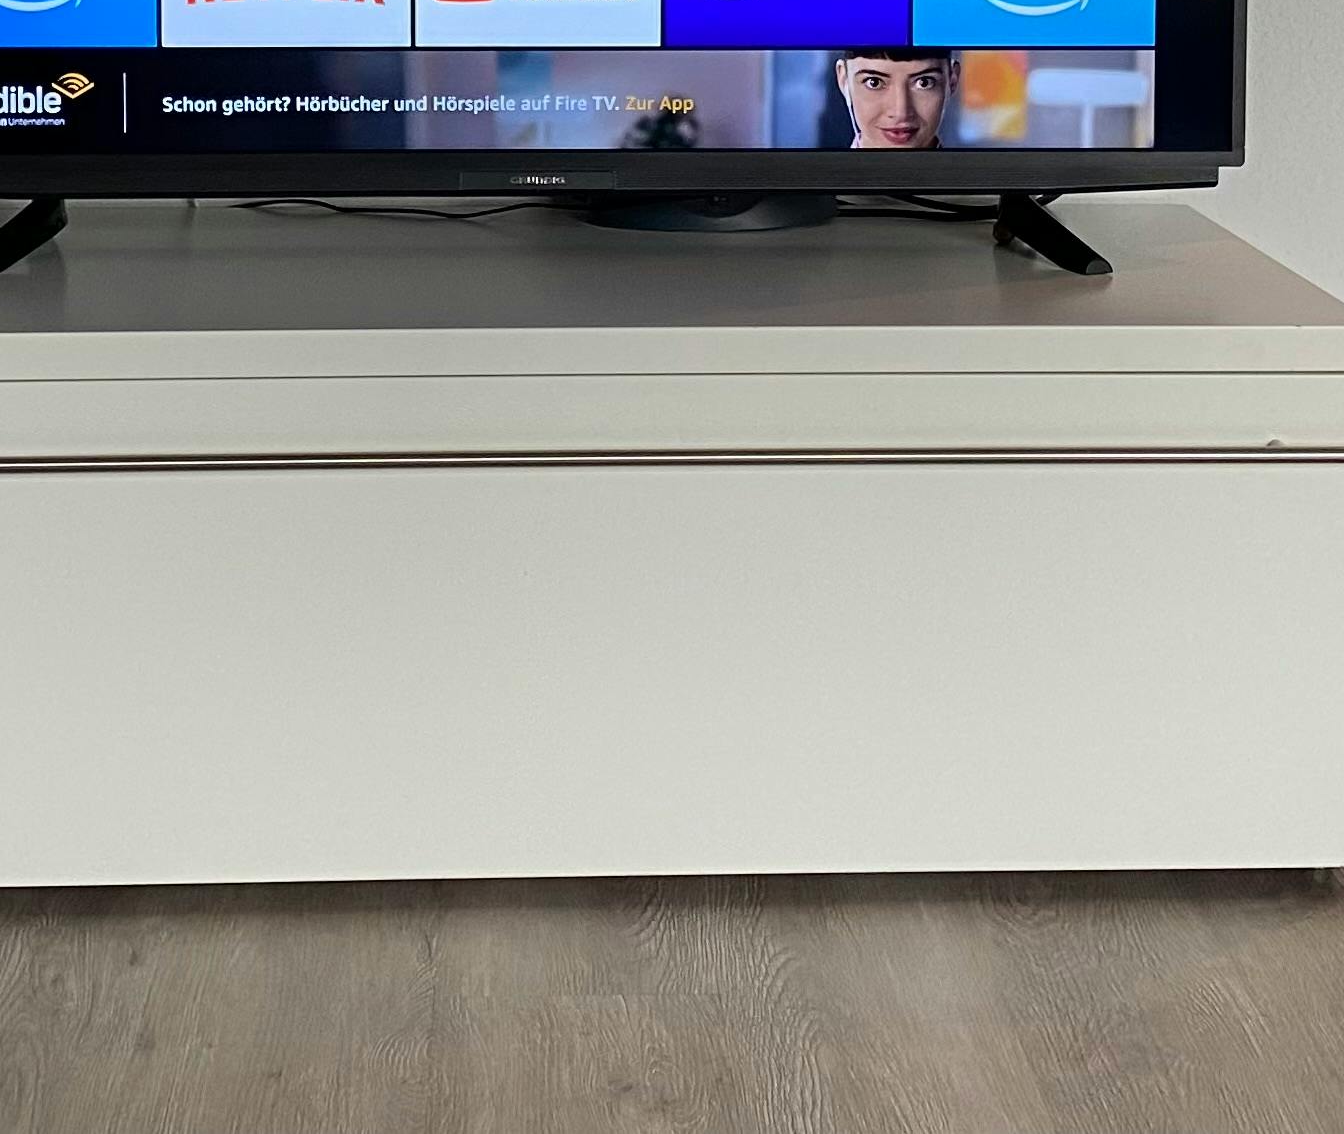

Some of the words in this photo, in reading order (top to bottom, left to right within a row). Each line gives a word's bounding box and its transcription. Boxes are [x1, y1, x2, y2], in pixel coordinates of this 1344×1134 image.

[162, 96, 217, 113] Schon
[222, 96, 290, 115] gehört?
[296, 96, 389, 113] Hörbücher
[394, 96, 427, 112] und
[433, 95, 516, 115] Hörspiele
[521, 95, 550, 112] auf
[555, 96, 587, 111] Fire
[592, 96, 619, 111] TV.
[625, 96, 655, 111] Zur
[659, 96, 694, 115] App
